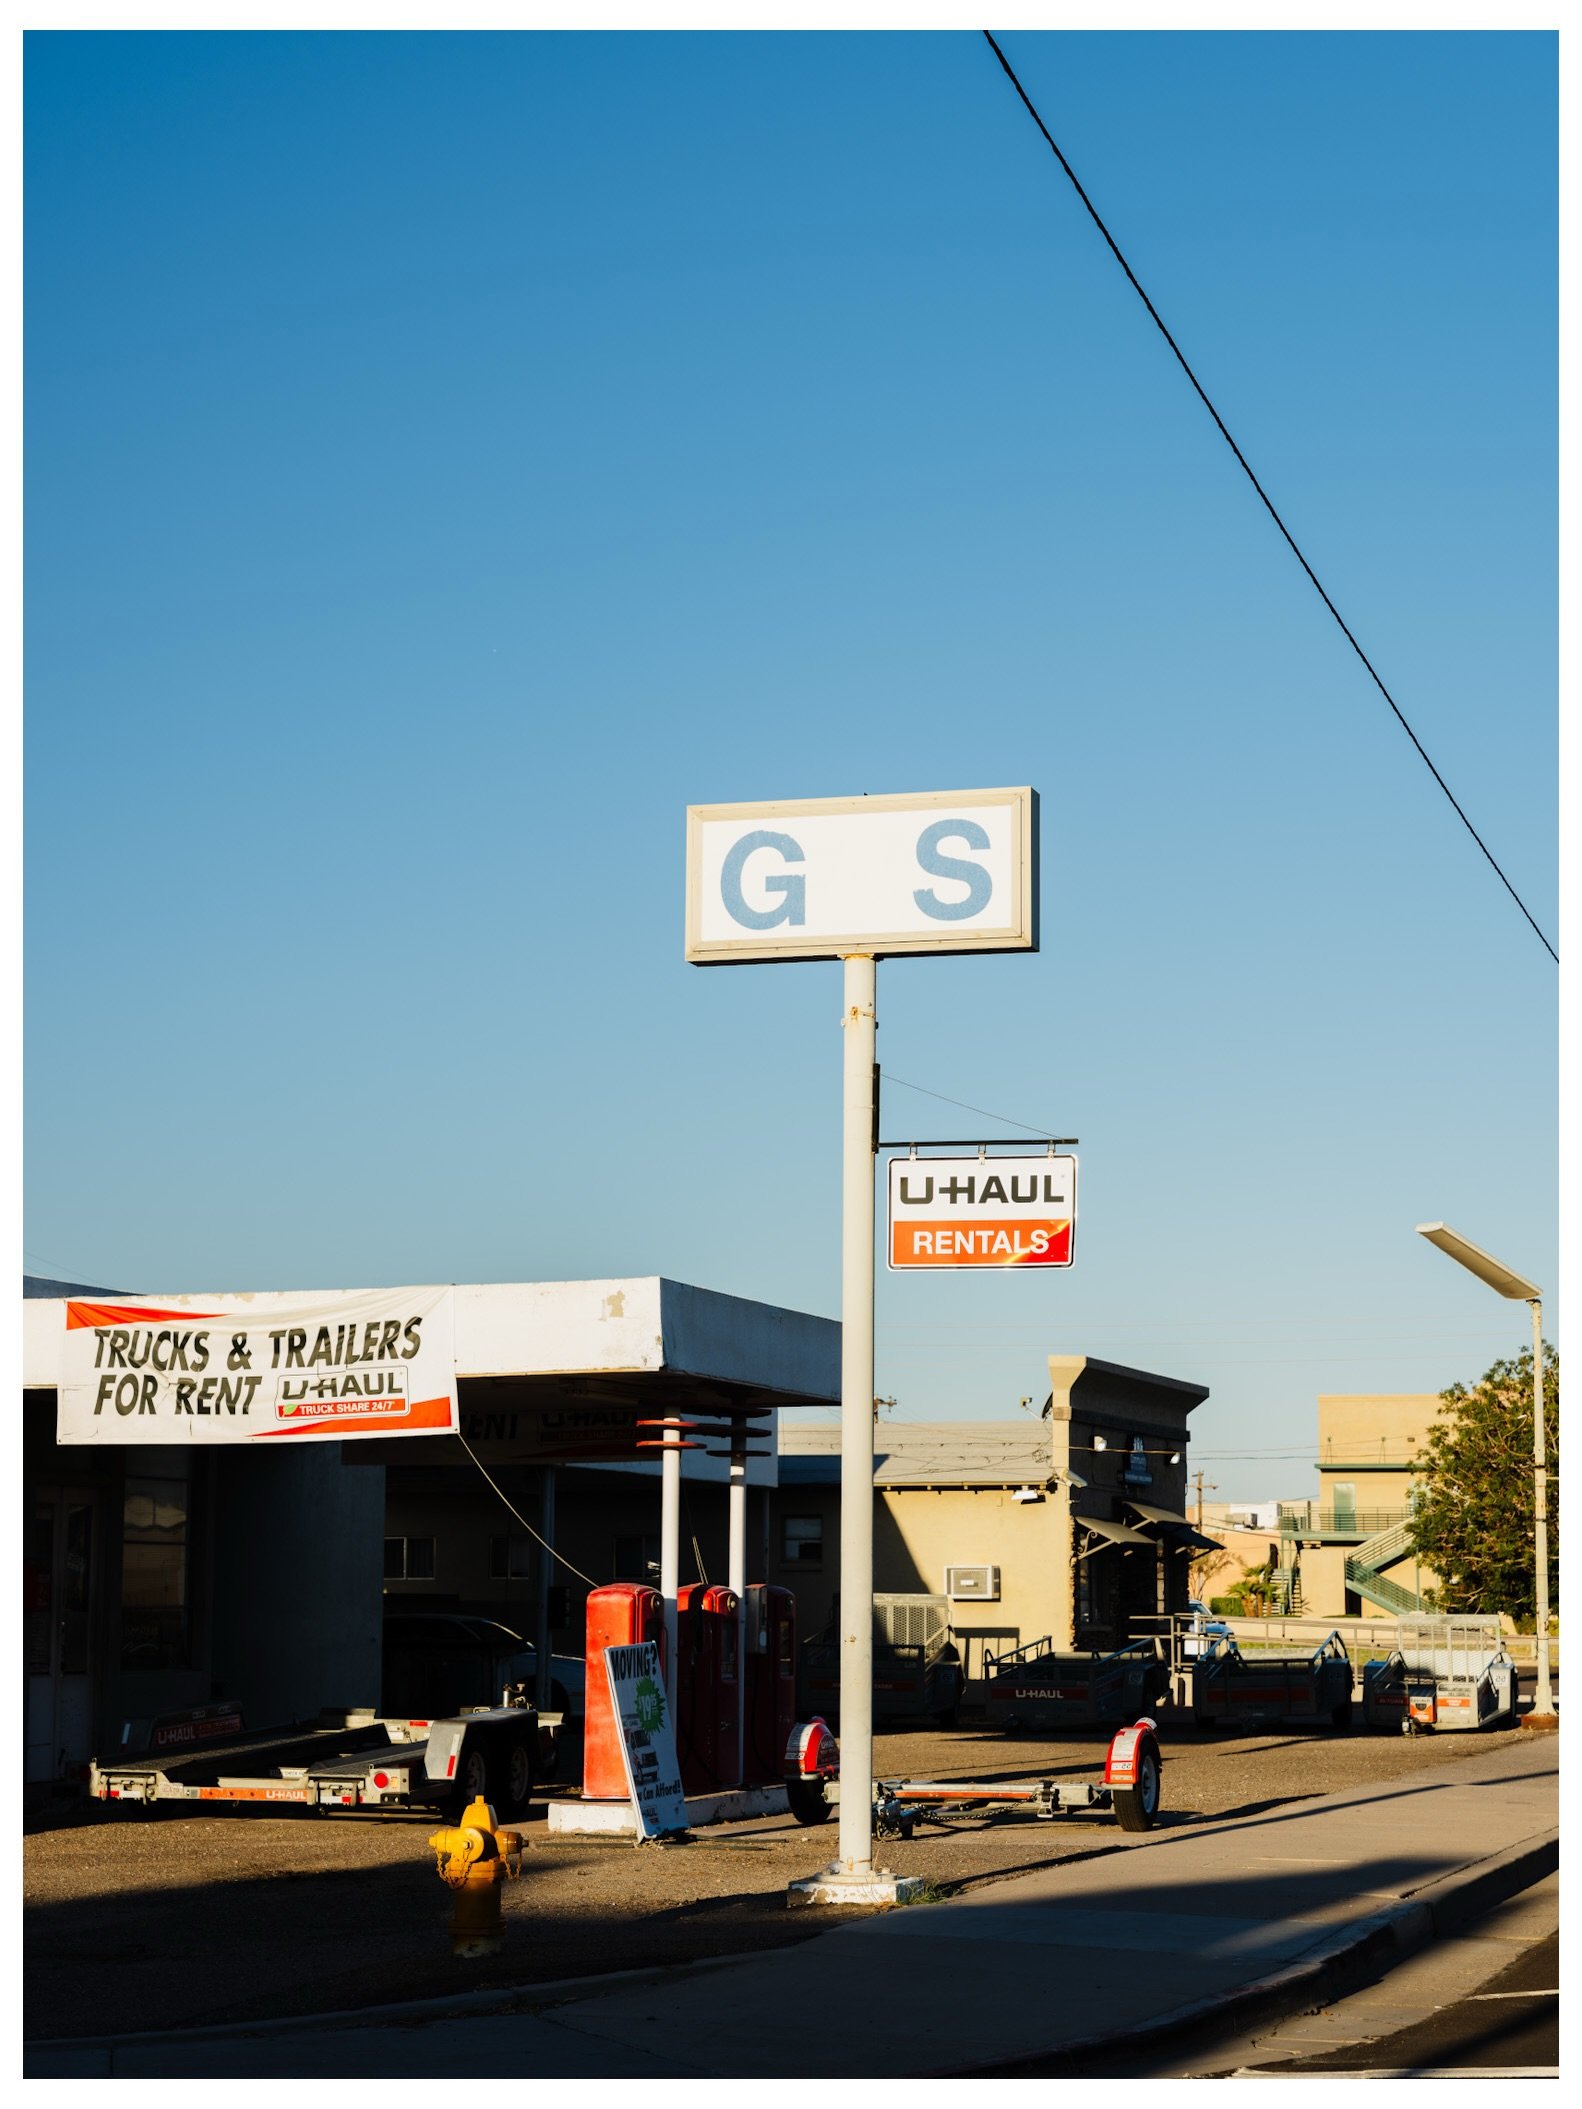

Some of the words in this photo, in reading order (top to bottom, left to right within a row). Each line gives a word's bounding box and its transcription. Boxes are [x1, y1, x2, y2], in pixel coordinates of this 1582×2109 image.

[899, 1175, 1065, 1205] U-HAUL
[913, 1229, 1050, 1255] RENTALS
[94, 1329, 210, 1371] TRUCKS
[227, 1331, 252, 1371] &
[268, 1315, 423, 1369] TRAILERS
[94, 1374, 158, 1416] FOR
[174, 1375, 262, 1415] RENT
[282, 1371, 404, 1400] U-HAUL
[299, 1403, 336, 1414] TRUCK
[336, 1401, 370, 1413] SHARE
[371, 1400, 394, 1412] 24/7
[611, 1645, 657, 1682] MOVING?
[1015, 1689, 1065, 1699] U-HAUL
[157, 1726, 196, 1745] U-HAUL
[265, 1789, 307, 1800] U-HAUL
